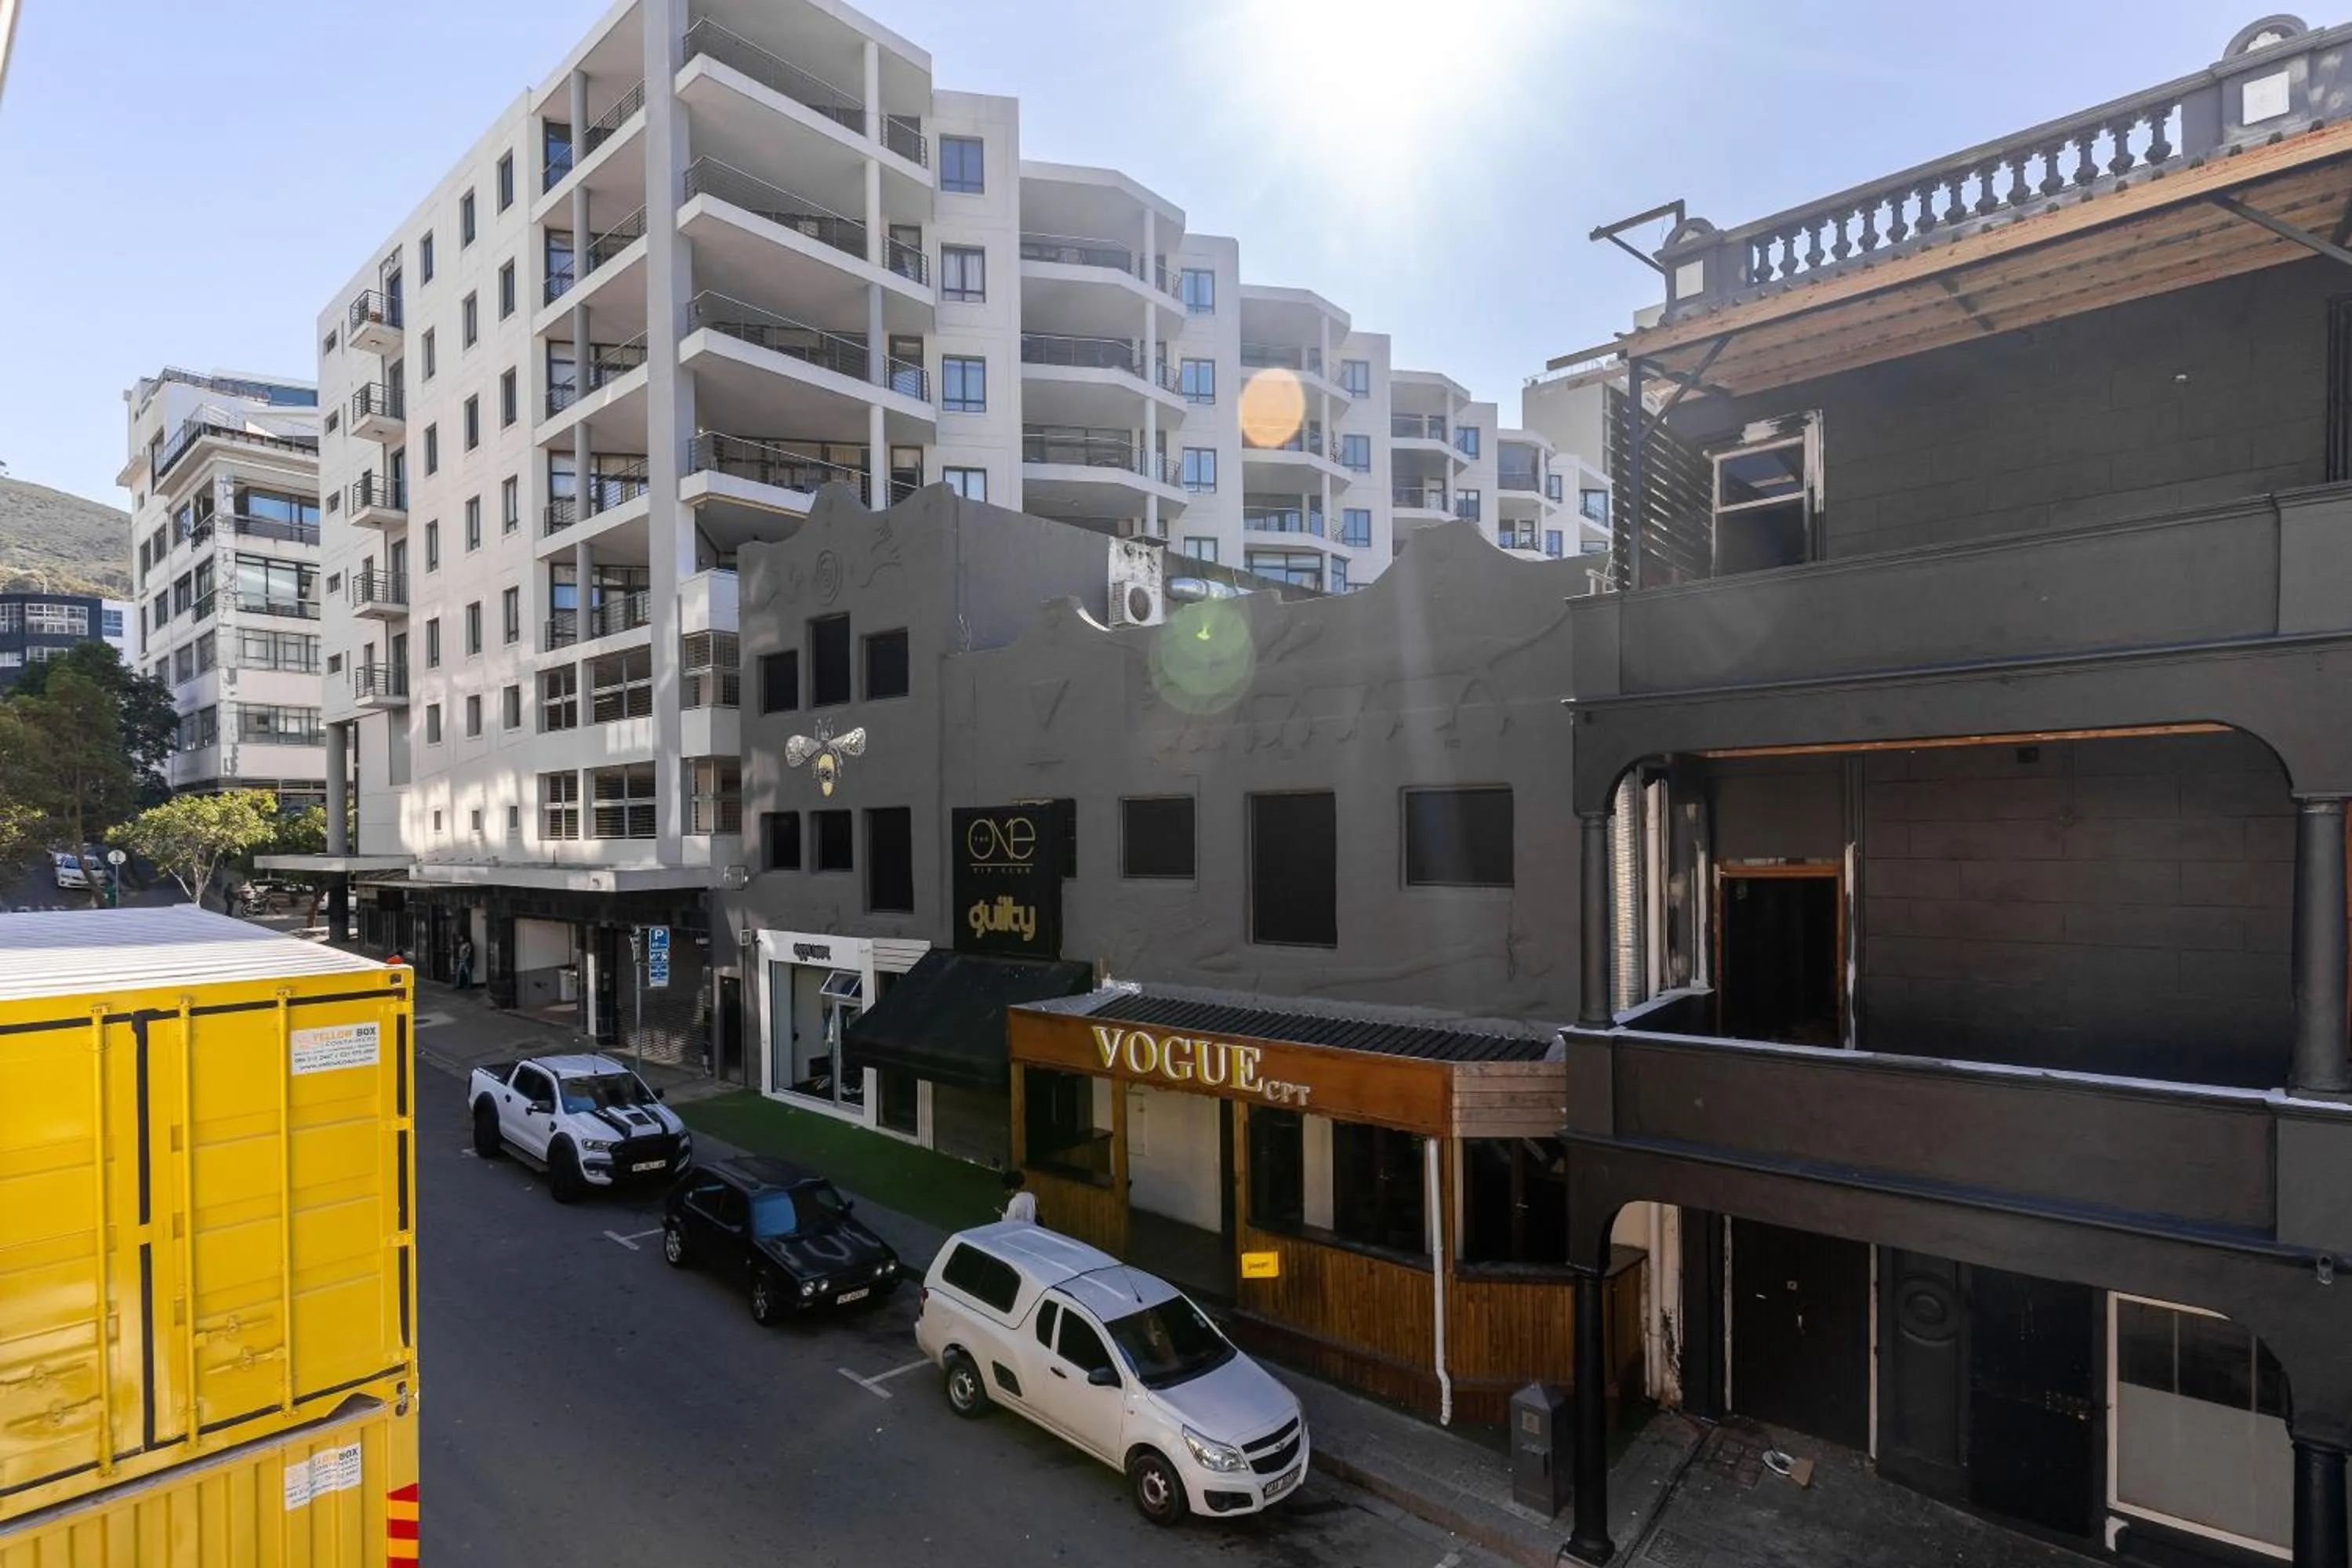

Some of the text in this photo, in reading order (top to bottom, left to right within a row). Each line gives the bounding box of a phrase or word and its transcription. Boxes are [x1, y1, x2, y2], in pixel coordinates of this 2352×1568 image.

[655, 928, 664, 940] P
[357, 1027, 376, 1036] BOX
[1092, 1026, 1264, 1093] VOGUE
[339, 1449, 358, 1461] BOX
